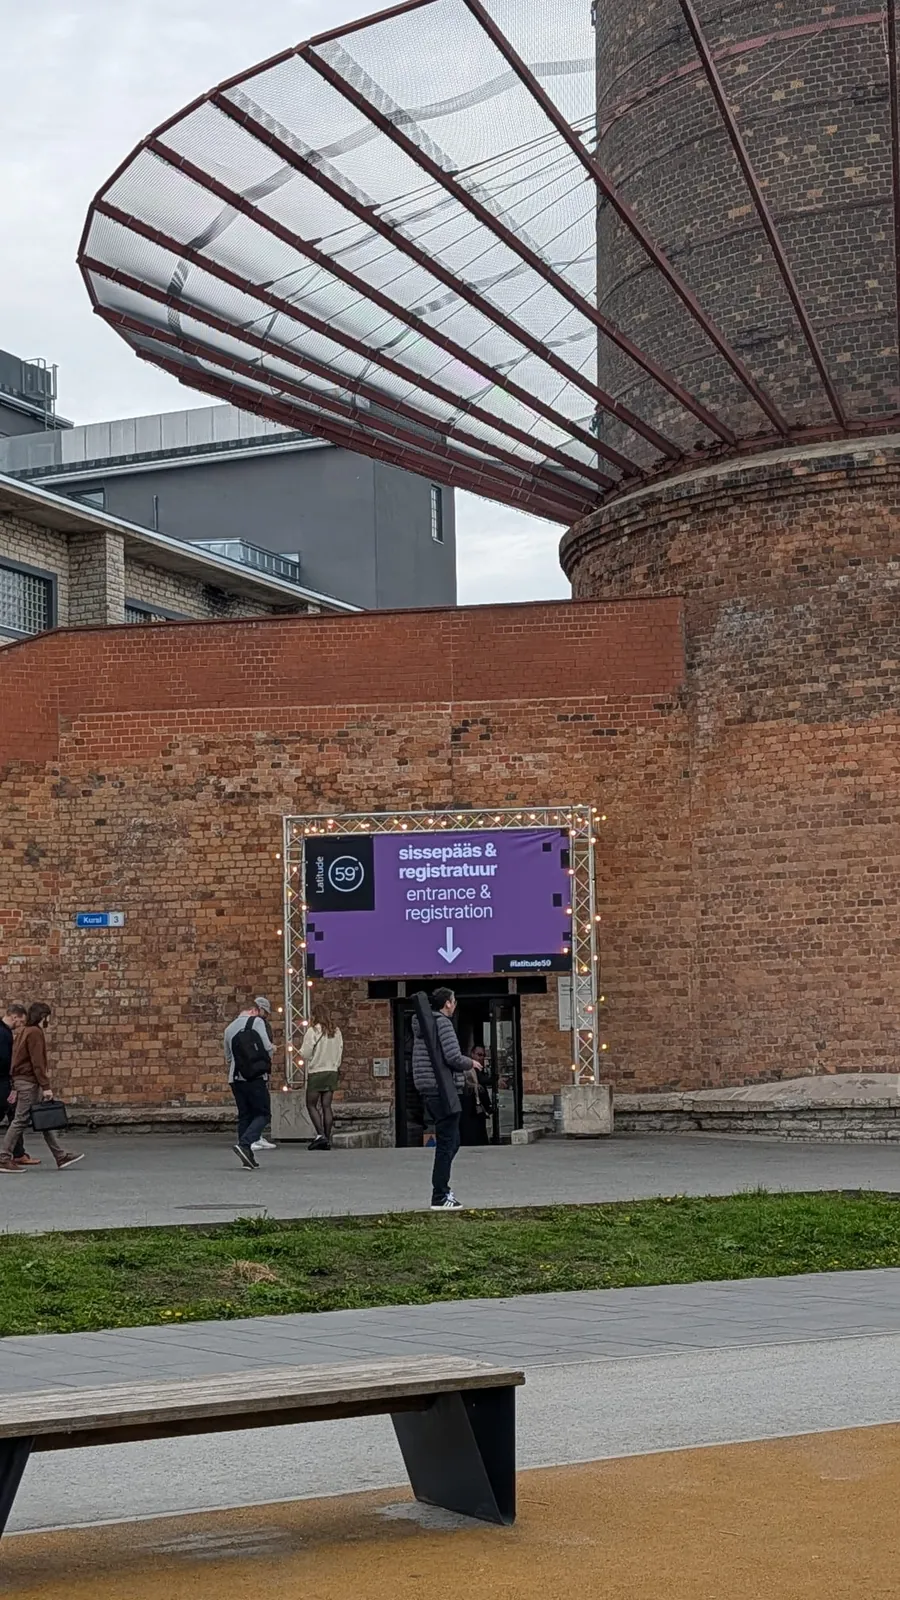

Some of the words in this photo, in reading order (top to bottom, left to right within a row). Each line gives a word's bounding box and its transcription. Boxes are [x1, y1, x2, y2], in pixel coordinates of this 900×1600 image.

[399, 843, 482, 862] sissepääs
[485, 843, 497, 857] &
[315, 856, 324, 893] Latitude
[399, 863, 498, 882] registratuur
[406, 887, 476, 901] entrance
[480, 884, 491, 899] &
[113, 916, 119, 924] 3
[405, 903, 493, 923] registration
